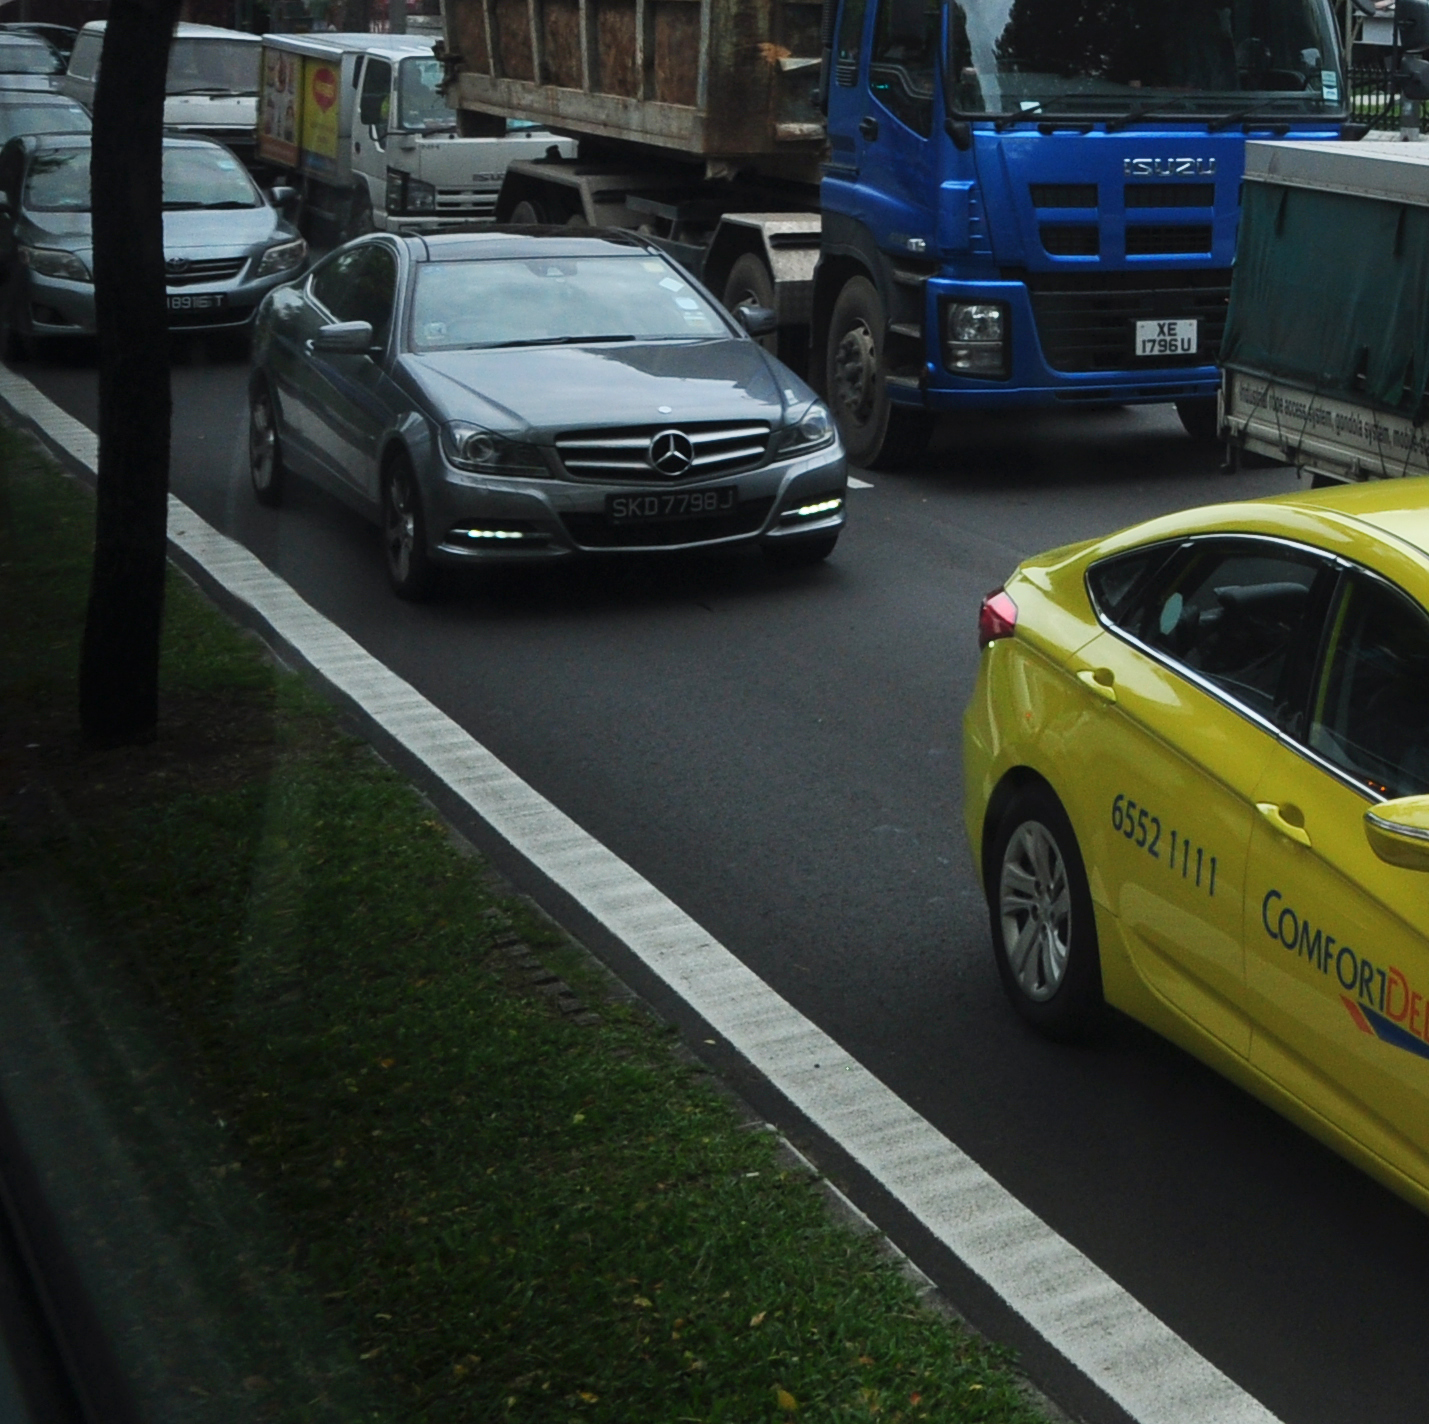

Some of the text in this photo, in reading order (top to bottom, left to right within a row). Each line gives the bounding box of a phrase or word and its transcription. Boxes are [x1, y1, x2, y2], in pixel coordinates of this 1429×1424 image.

[1124, 158, 1215, 175] ISUZU
[1157, 322, 1178, 337] XE
[1112, 793, 1216, 896] 6552 1111
